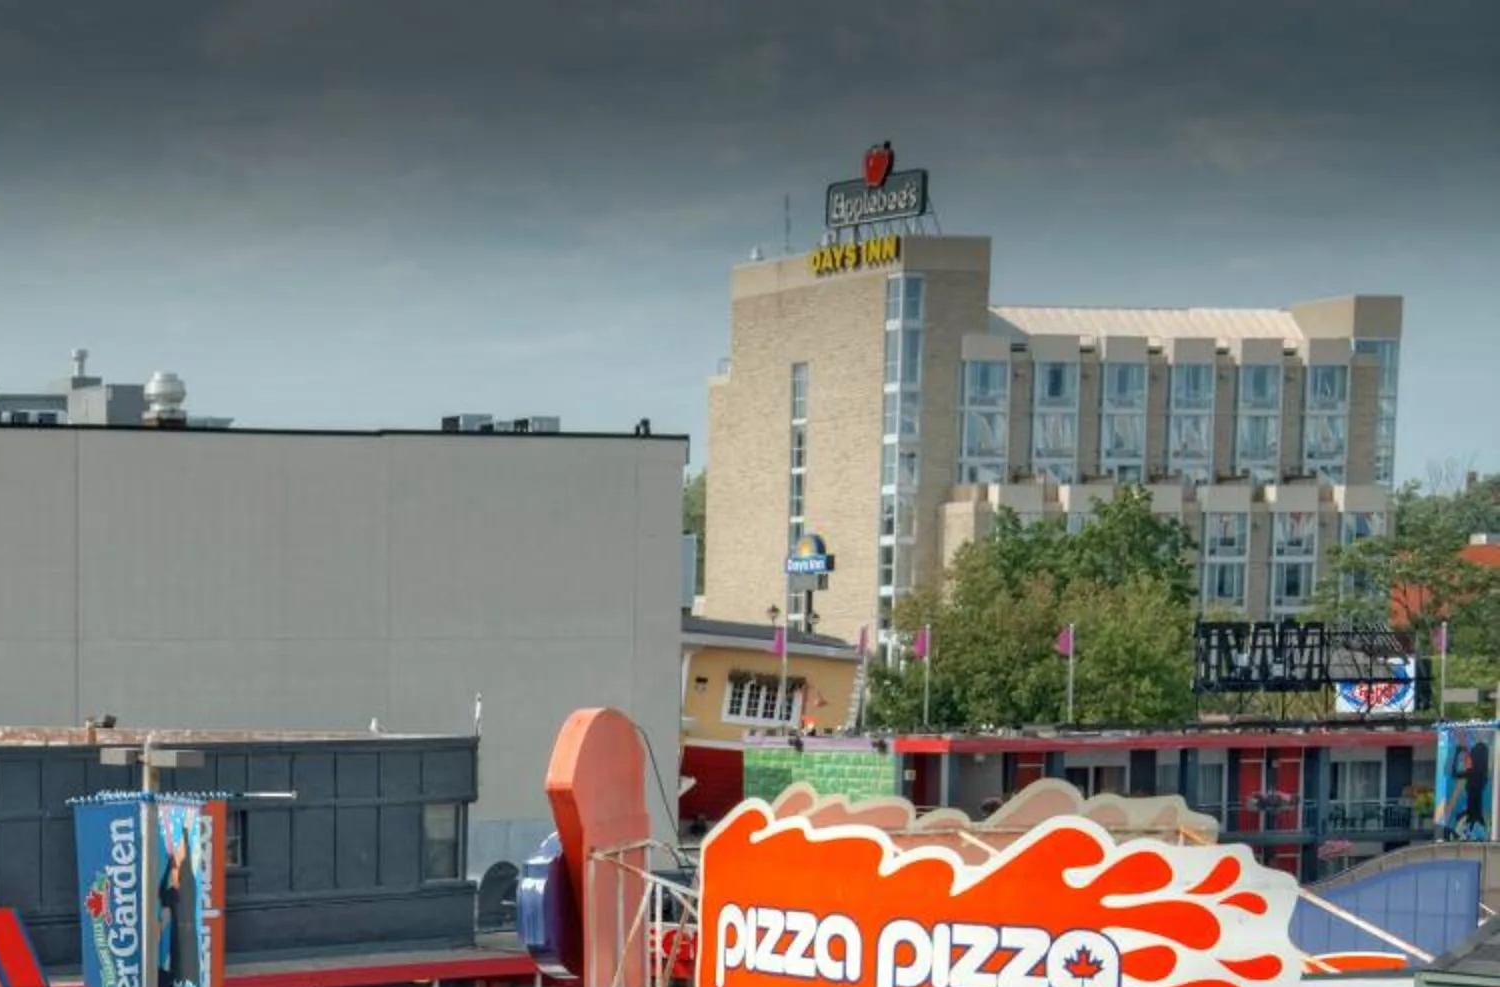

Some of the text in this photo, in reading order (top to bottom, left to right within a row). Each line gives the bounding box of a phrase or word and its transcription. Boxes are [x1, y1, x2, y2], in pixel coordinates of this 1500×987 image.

[811, 233, 898, 273] DAYS INN
[107, 815, 138, 960] Garden
